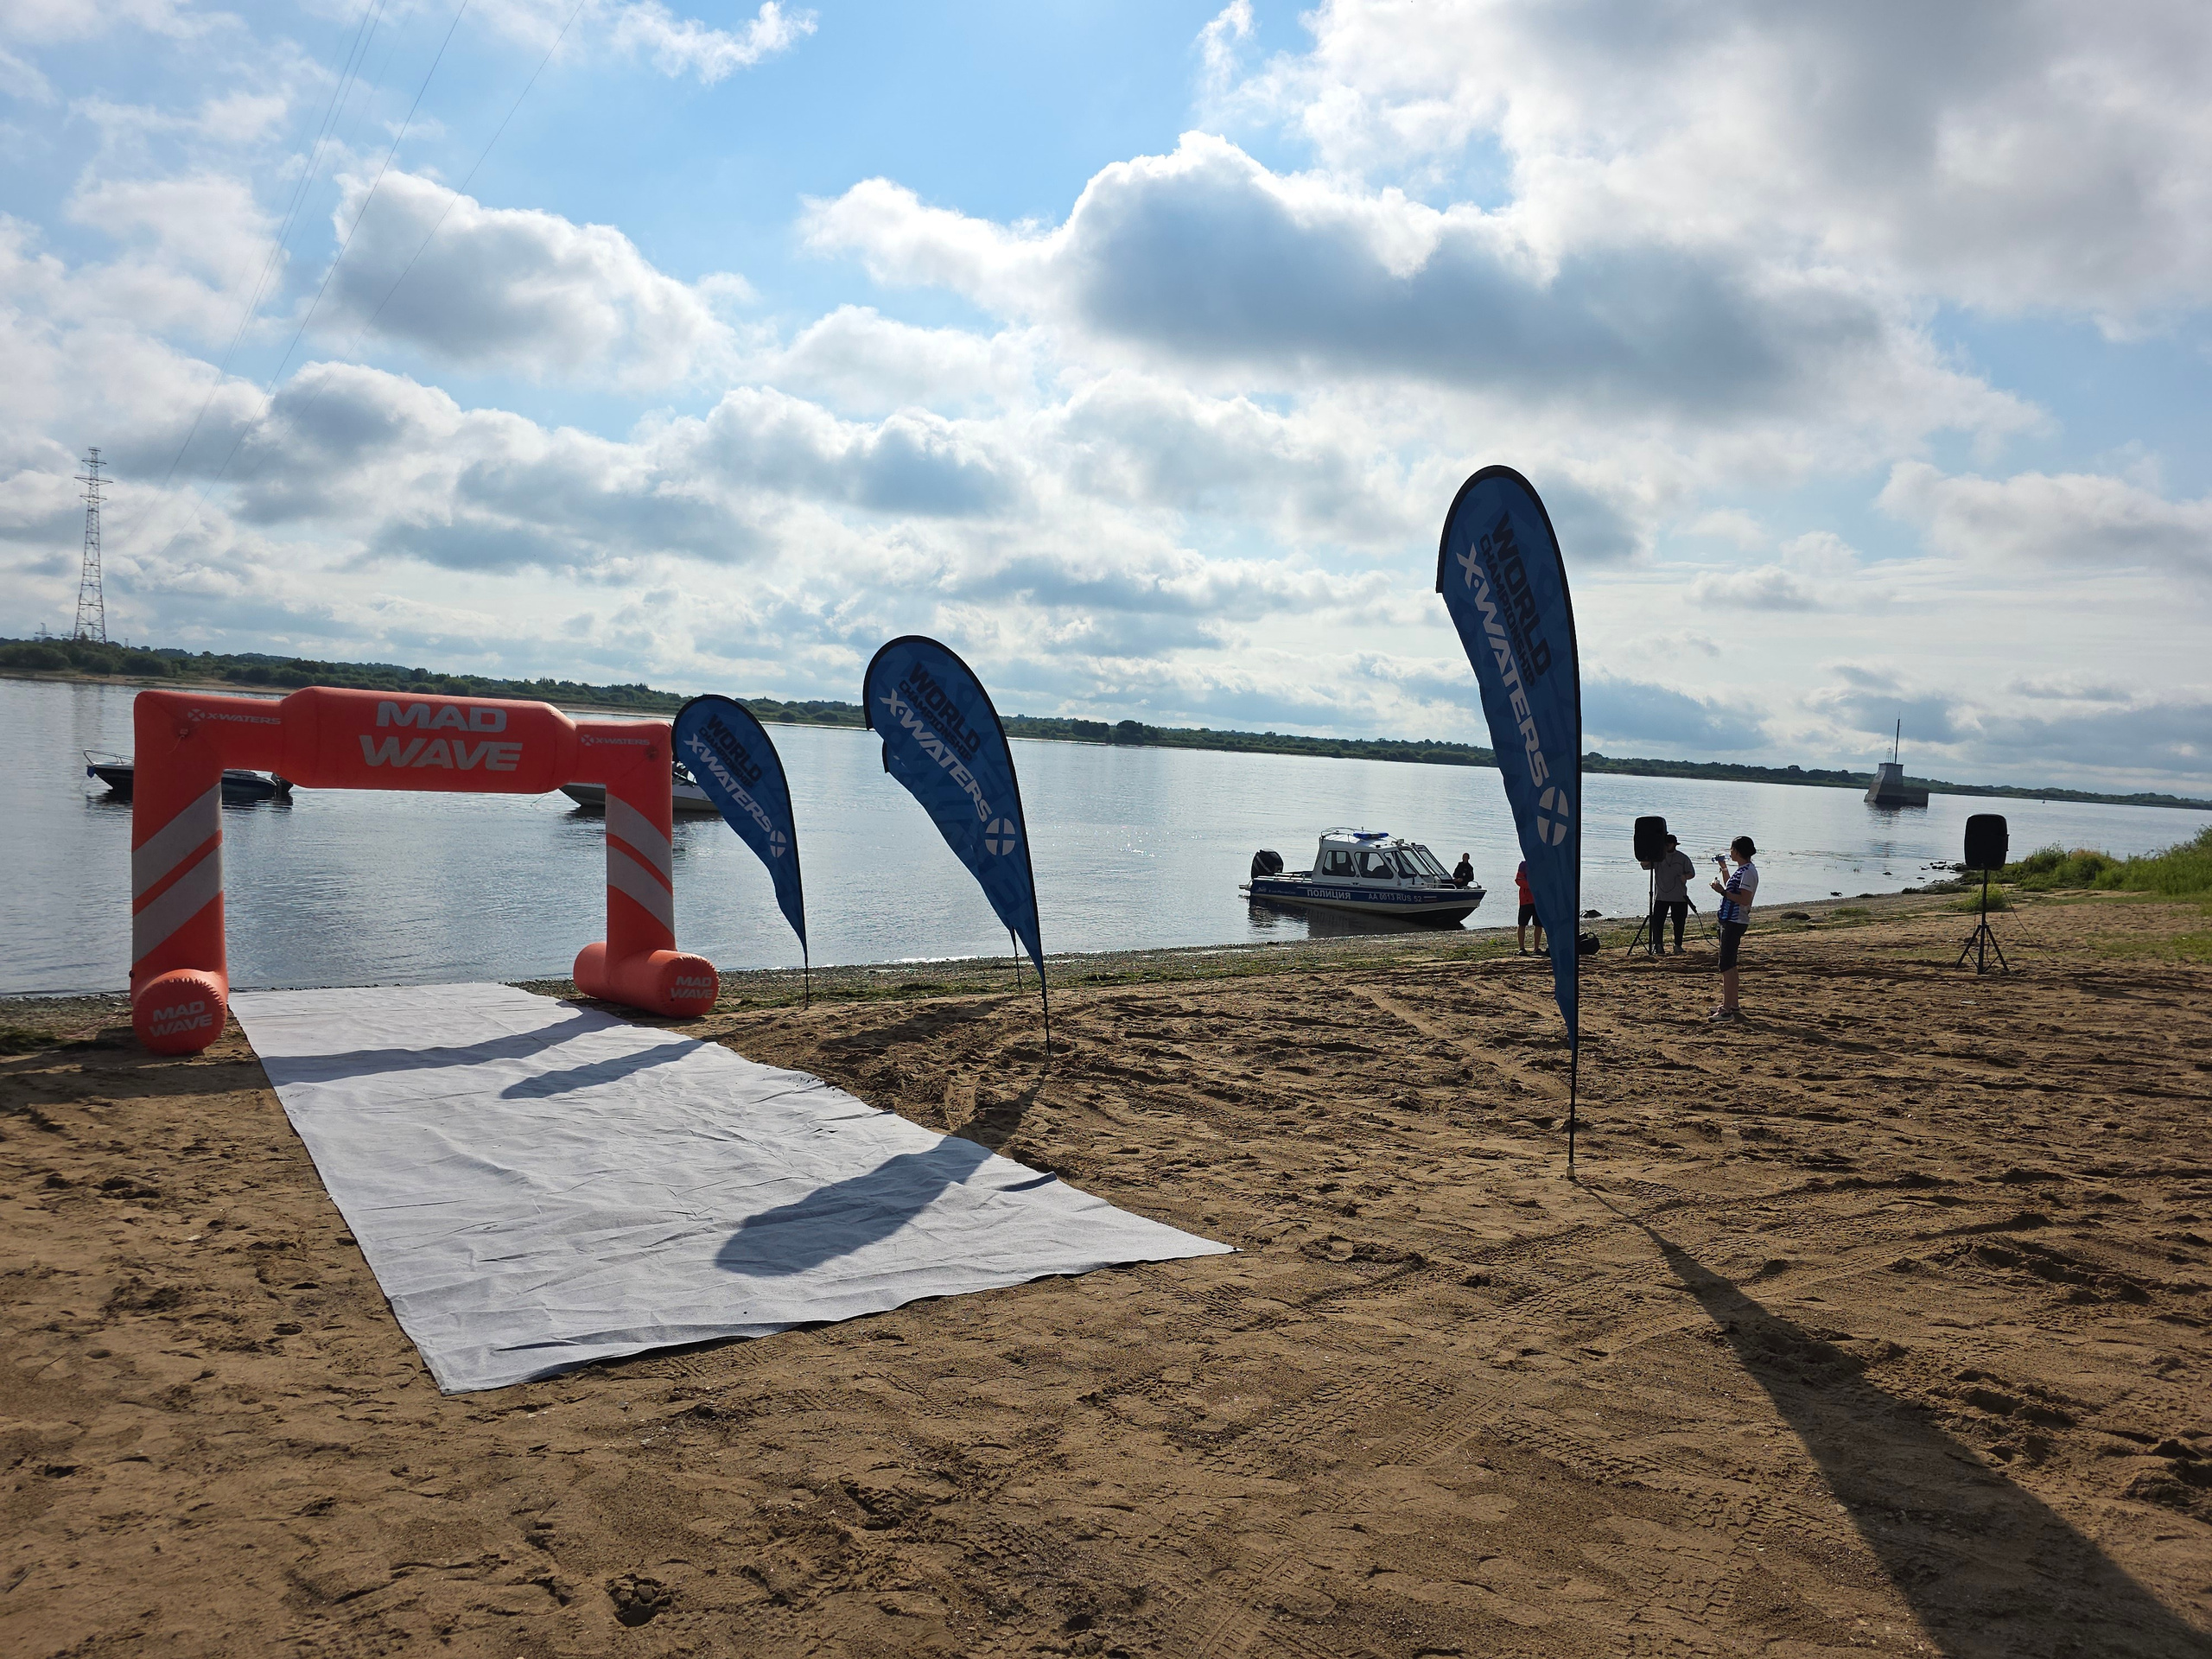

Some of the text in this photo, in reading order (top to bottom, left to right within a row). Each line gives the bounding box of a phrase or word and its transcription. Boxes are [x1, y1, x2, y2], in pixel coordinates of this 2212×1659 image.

[1479, 533, 1535, 687] CHAMPIONSHIP
[1491, 511, 1552, 676] WORLD
[376, 701, 507, 733] MAD
[899, 680, 973, 760] CHAMPIONSHIP
[909, 661, 981, 753] WORLD
[359, 734, 523, 771] WAVE
[699, 727, 754, 788] CHAMPIONSHIP
[707, 714, 762, 782] WORLD
[1306, 889, 1351, 899] ПОЛИЦИЯ
[1396, 893, 1412, 902] RUS
[670, 988, 714, 999] WAVE
[676, 976, 712, 988] MAD
[149, 1014, 213, 1037] WAVE
[153, 1001, 205, 1022] MAD
